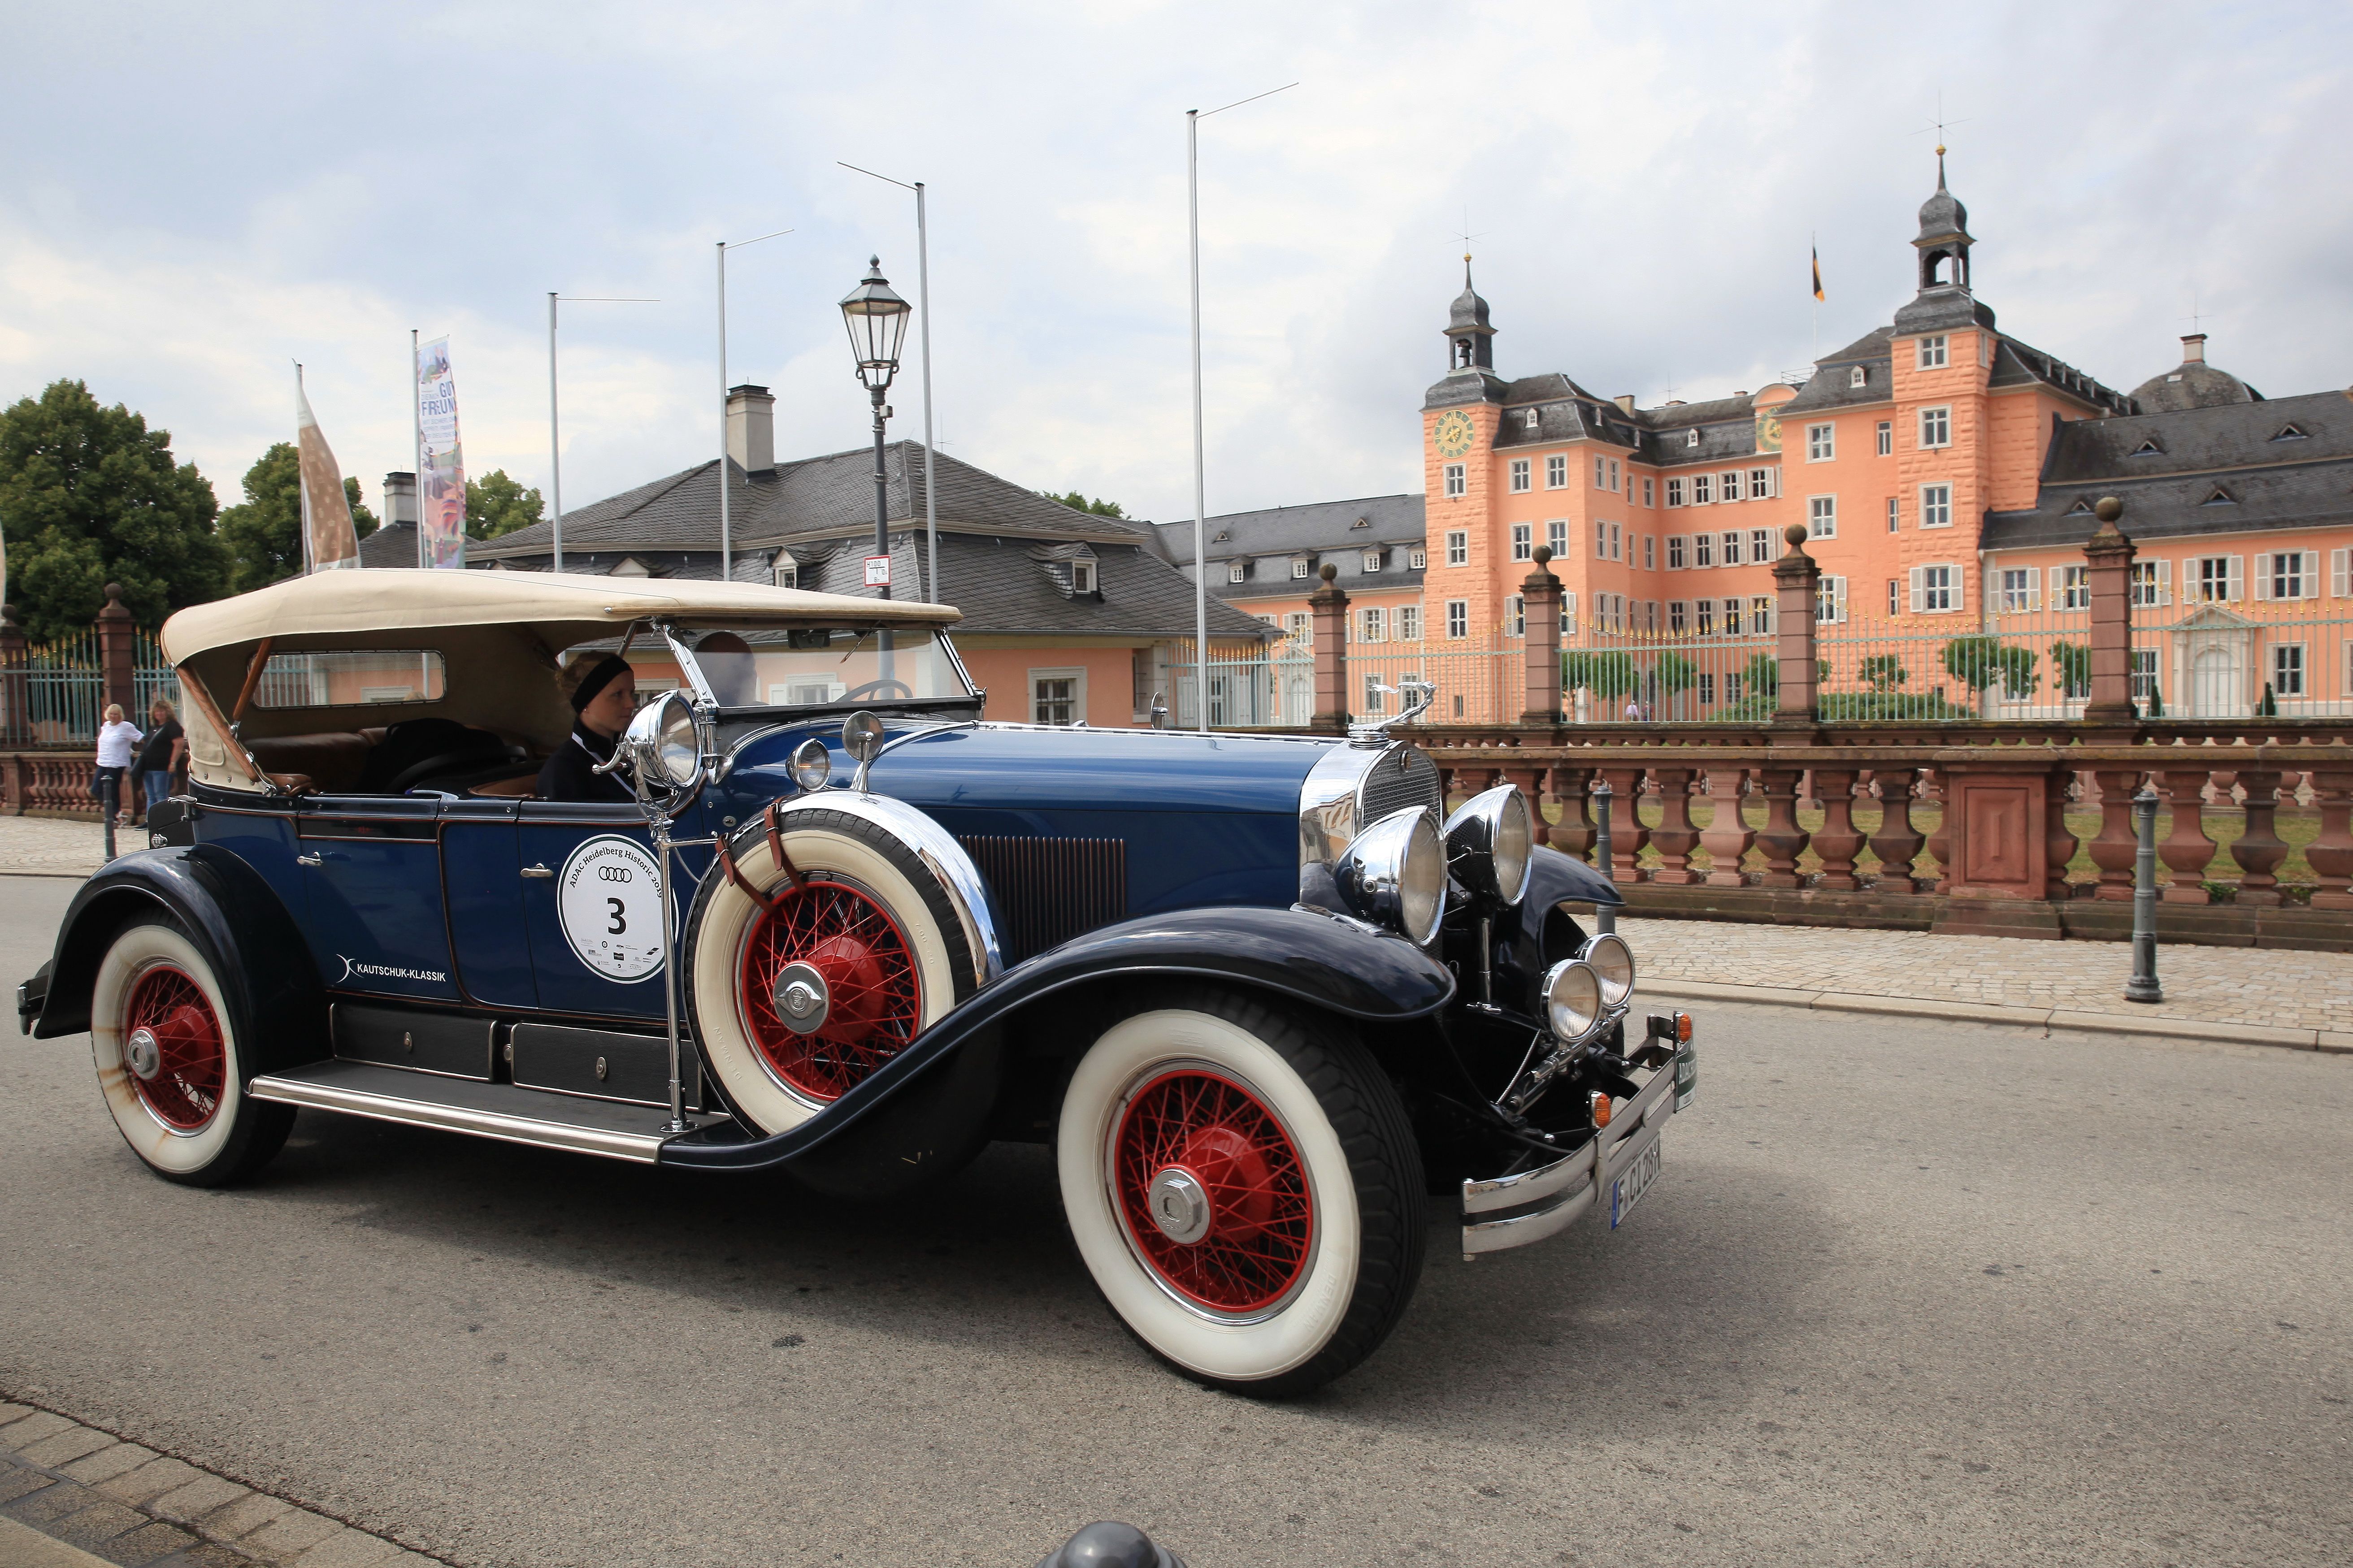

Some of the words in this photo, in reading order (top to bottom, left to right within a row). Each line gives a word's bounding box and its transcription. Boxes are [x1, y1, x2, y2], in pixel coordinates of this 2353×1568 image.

[570, 862, 584, 888] ADAC
[583, 847, 623, 865] Heidelberg
[625, 850, 653, 877] Historic
[651, 877, 662, 898] 2019
[607, 897, 627, 935] 3
[357, 964, 446, 982] KAUTSCHUK-KLASSIK
[1618, 1179, 1625, 1217] F
